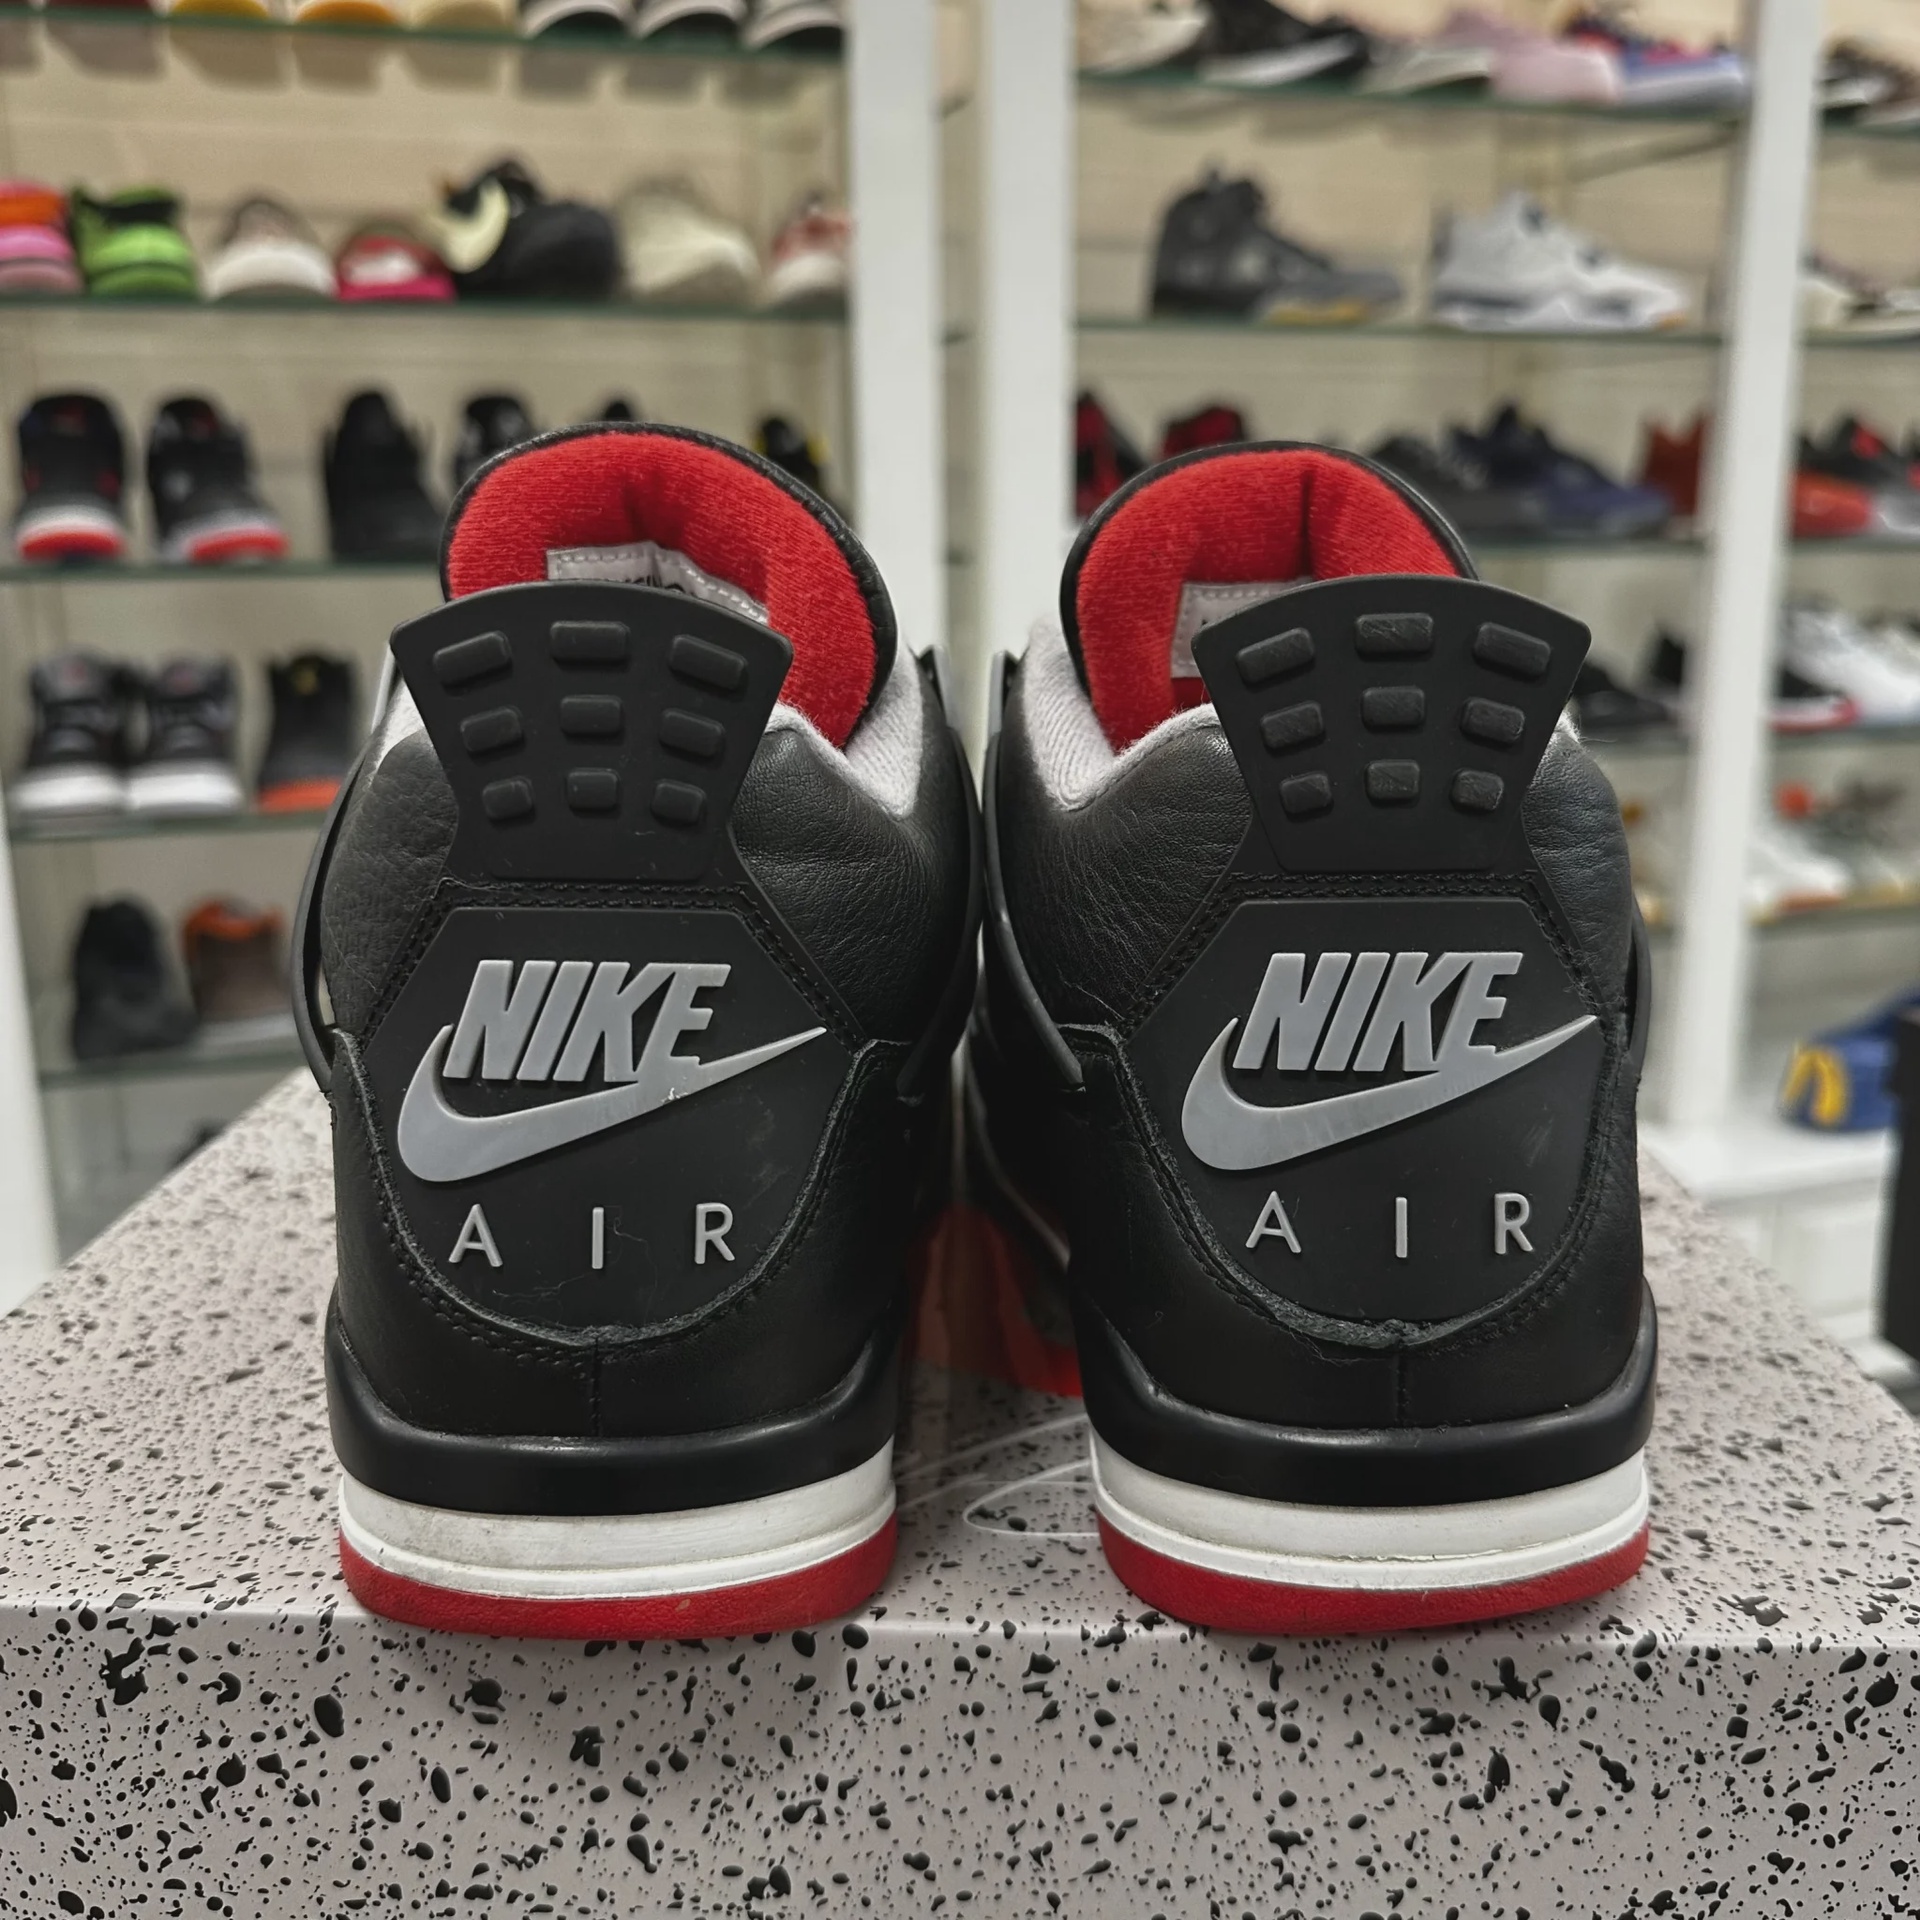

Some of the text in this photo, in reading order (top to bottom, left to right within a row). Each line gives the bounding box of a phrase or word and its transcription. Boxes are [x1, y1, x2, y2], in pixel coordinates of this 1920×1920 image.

[443, 959, 732, 1083] NIKE
[1232, 951, 1524, 1072] NIKE
[448, 1202, 736, 1270] AIR
[1245, 1190, 1534, 1258] AIR
